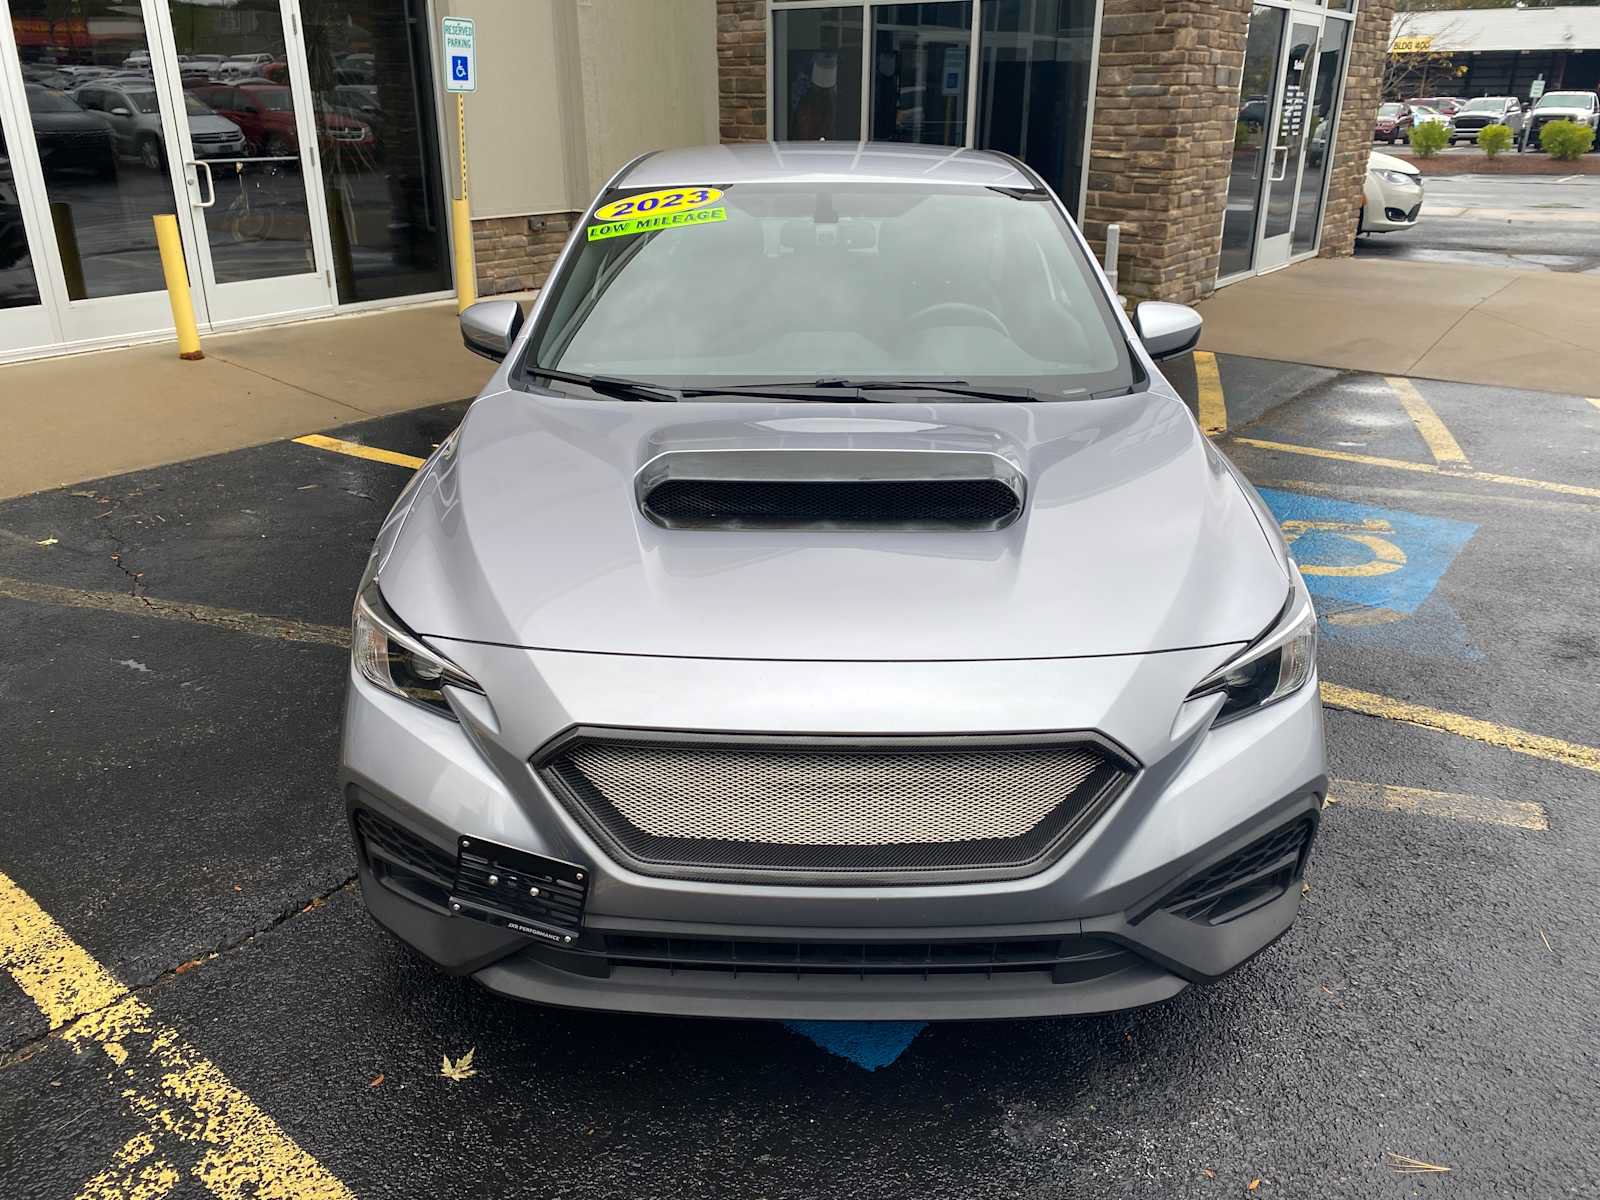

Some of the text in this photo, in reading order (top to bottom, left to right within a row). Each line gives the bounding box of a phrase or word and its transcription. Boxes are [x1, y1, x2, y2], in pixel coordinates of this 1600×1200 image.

[445, 25, 472, 36] RESERVED
[447, 38, 471, 48] PARKING
[1393, 41, 1412, 50] BLDG
[612, 190, 709, 217] 2023
[590, 209, 722, 237] LOW MILEAGE
[519, 925, 560, 941] PERFORMANCE
